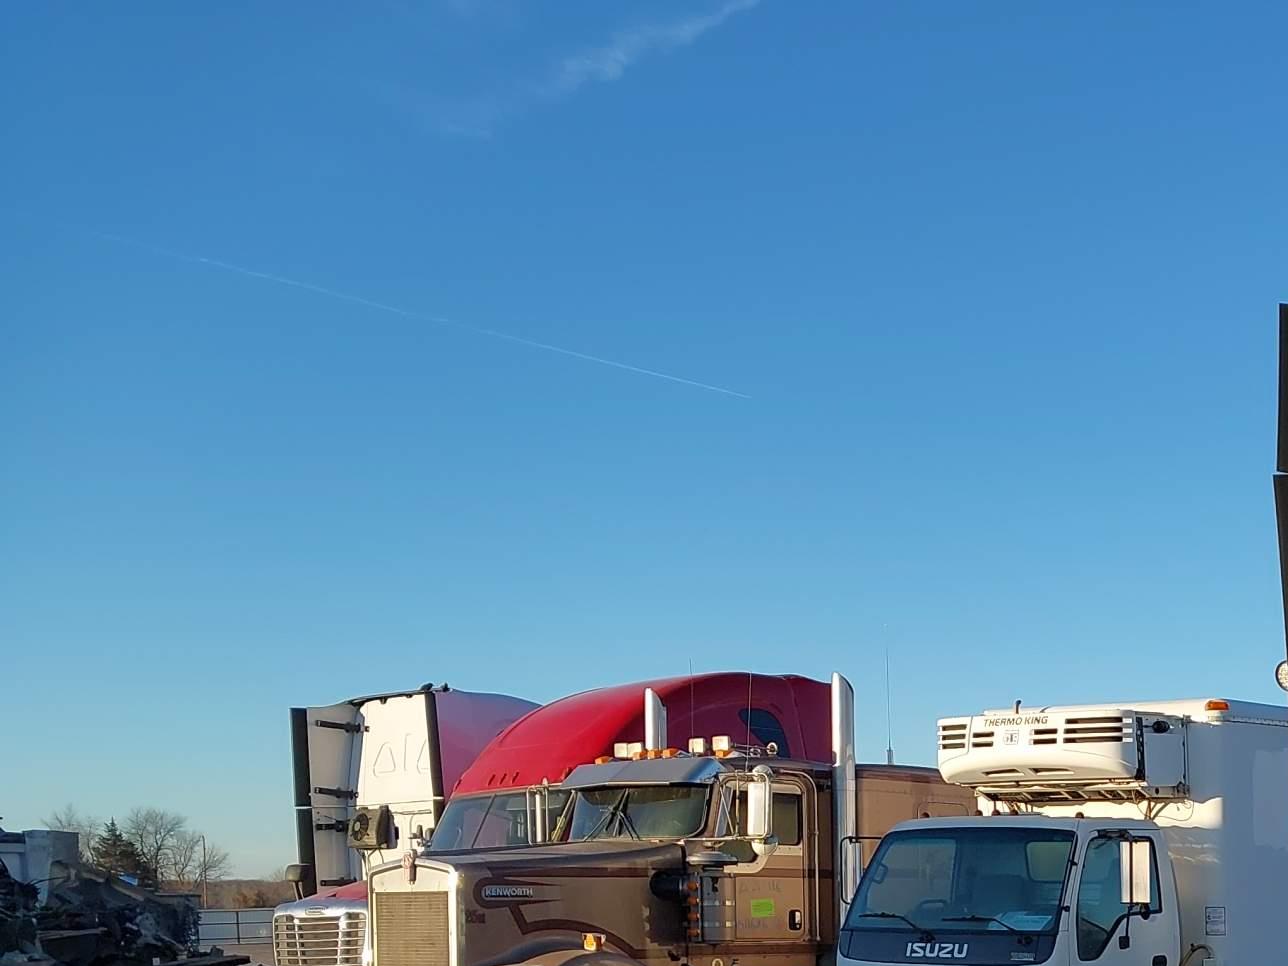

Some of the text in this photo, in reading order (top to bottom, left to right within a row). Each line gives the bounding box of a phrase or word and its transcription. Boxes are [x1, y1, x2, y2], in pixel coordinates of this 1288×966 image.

[983, 716, 1049, 727] THERMO KING
[485, 887, 534, 897] KENWORTH
[905, 942, 969, 958] ISUZU
